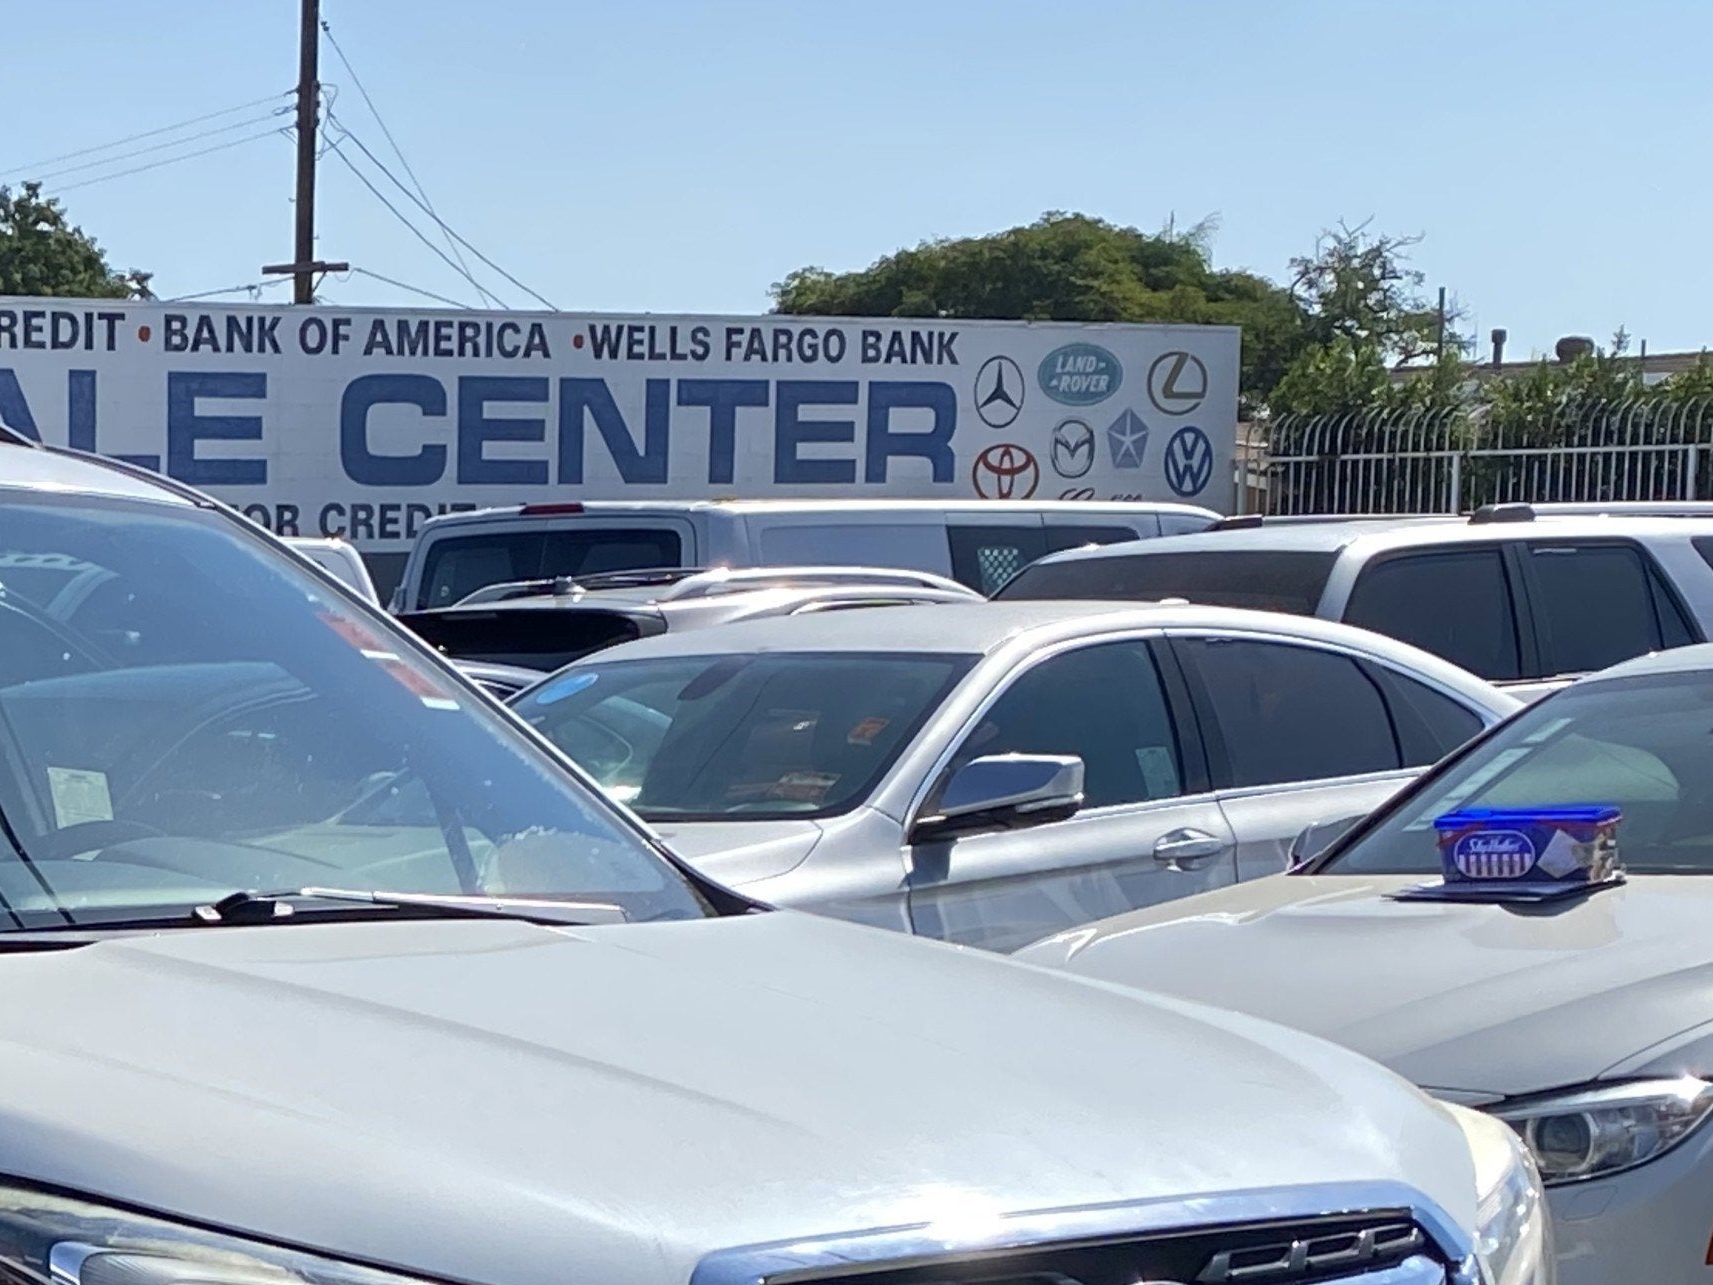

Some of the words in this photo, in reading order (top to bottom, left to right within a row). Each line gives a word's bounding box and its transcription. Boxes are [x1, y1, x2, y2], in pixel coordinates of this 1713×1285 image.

[163, 313, 282, 357] BANK
[298, 315, 353, 357] OF
[362, 318, 551, 361] AMERICA
[588, 323, 711, 363] WELLS
[725, 326, 847, 365] FARGO
[860, 329, 960, 366] BANK
[339, 372, 958, 487] CENTER
